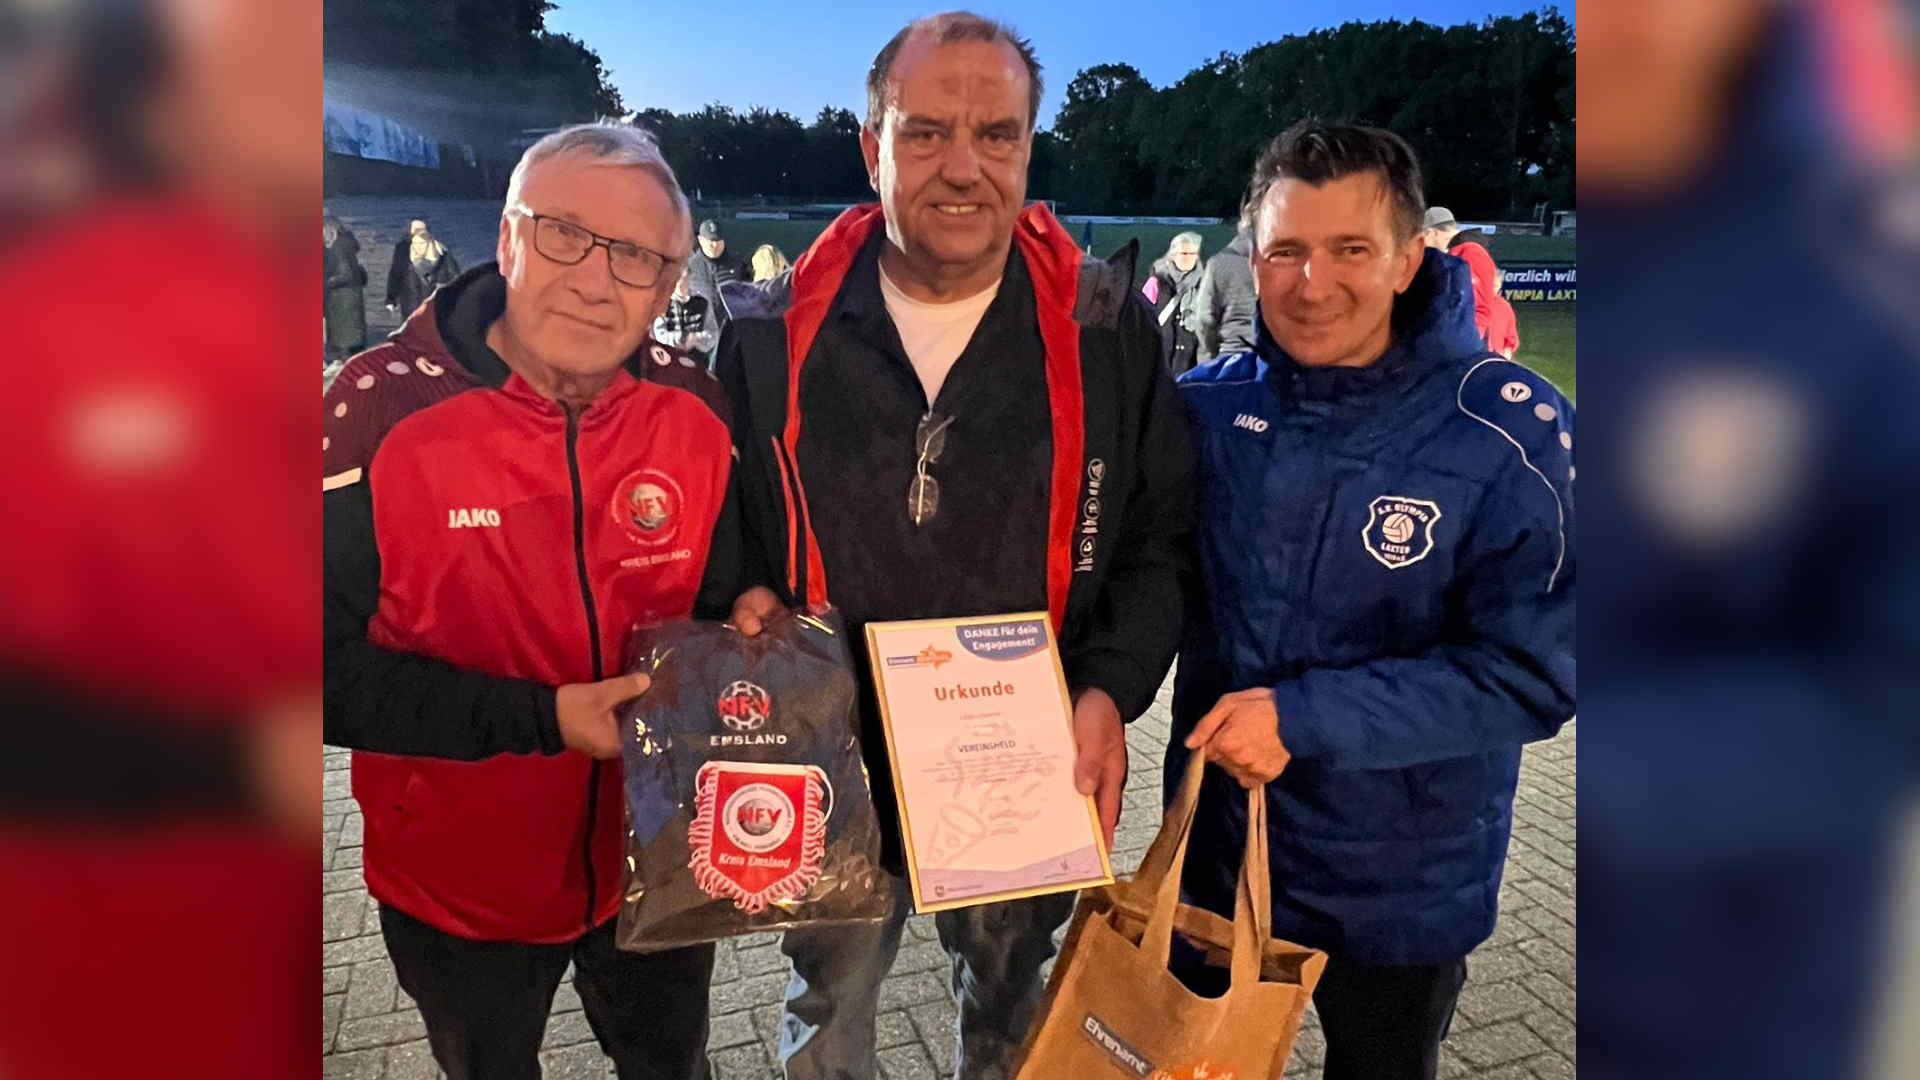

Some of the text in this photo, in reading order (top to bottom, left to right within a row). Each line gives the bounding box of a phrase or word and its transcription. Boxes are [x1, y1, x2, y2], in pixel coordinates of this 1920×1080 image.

[1555, 269, 1576, 282] wil
[1500, 289, 1543, 300] YMPIA
[934, 680, 1015, 701] Urkunde
[710, 733, 788, 747] EMSLAND
[737, 806, 782, 824] NFV
[1084, 1016, 1148, 1075] Ehrenamt
